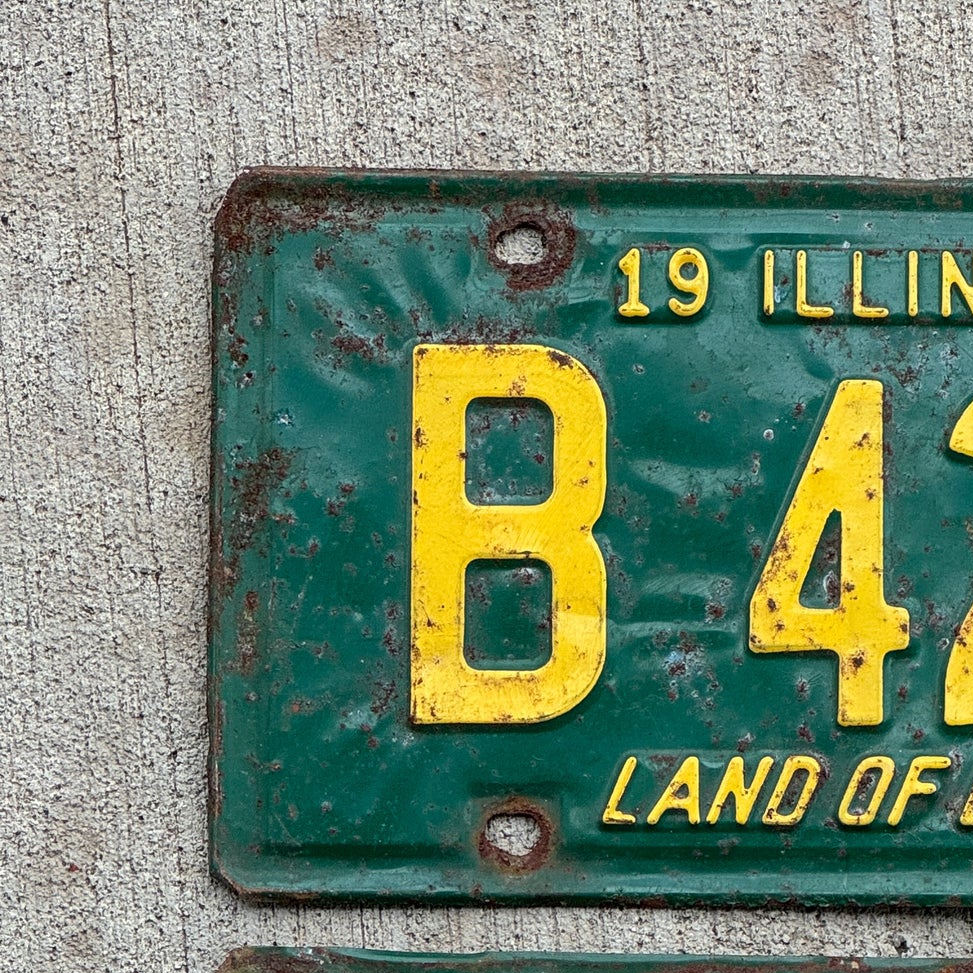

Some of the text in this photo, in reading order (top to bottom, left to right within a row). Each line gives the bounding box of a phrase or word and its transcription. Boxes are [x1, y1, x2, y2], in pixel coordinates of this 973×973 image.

[618, 247, 710, 317] 19
[410, 342, 609, 726] B
[601, 755, 823, 826] LAND
[837, 755, 951, 827] OF
